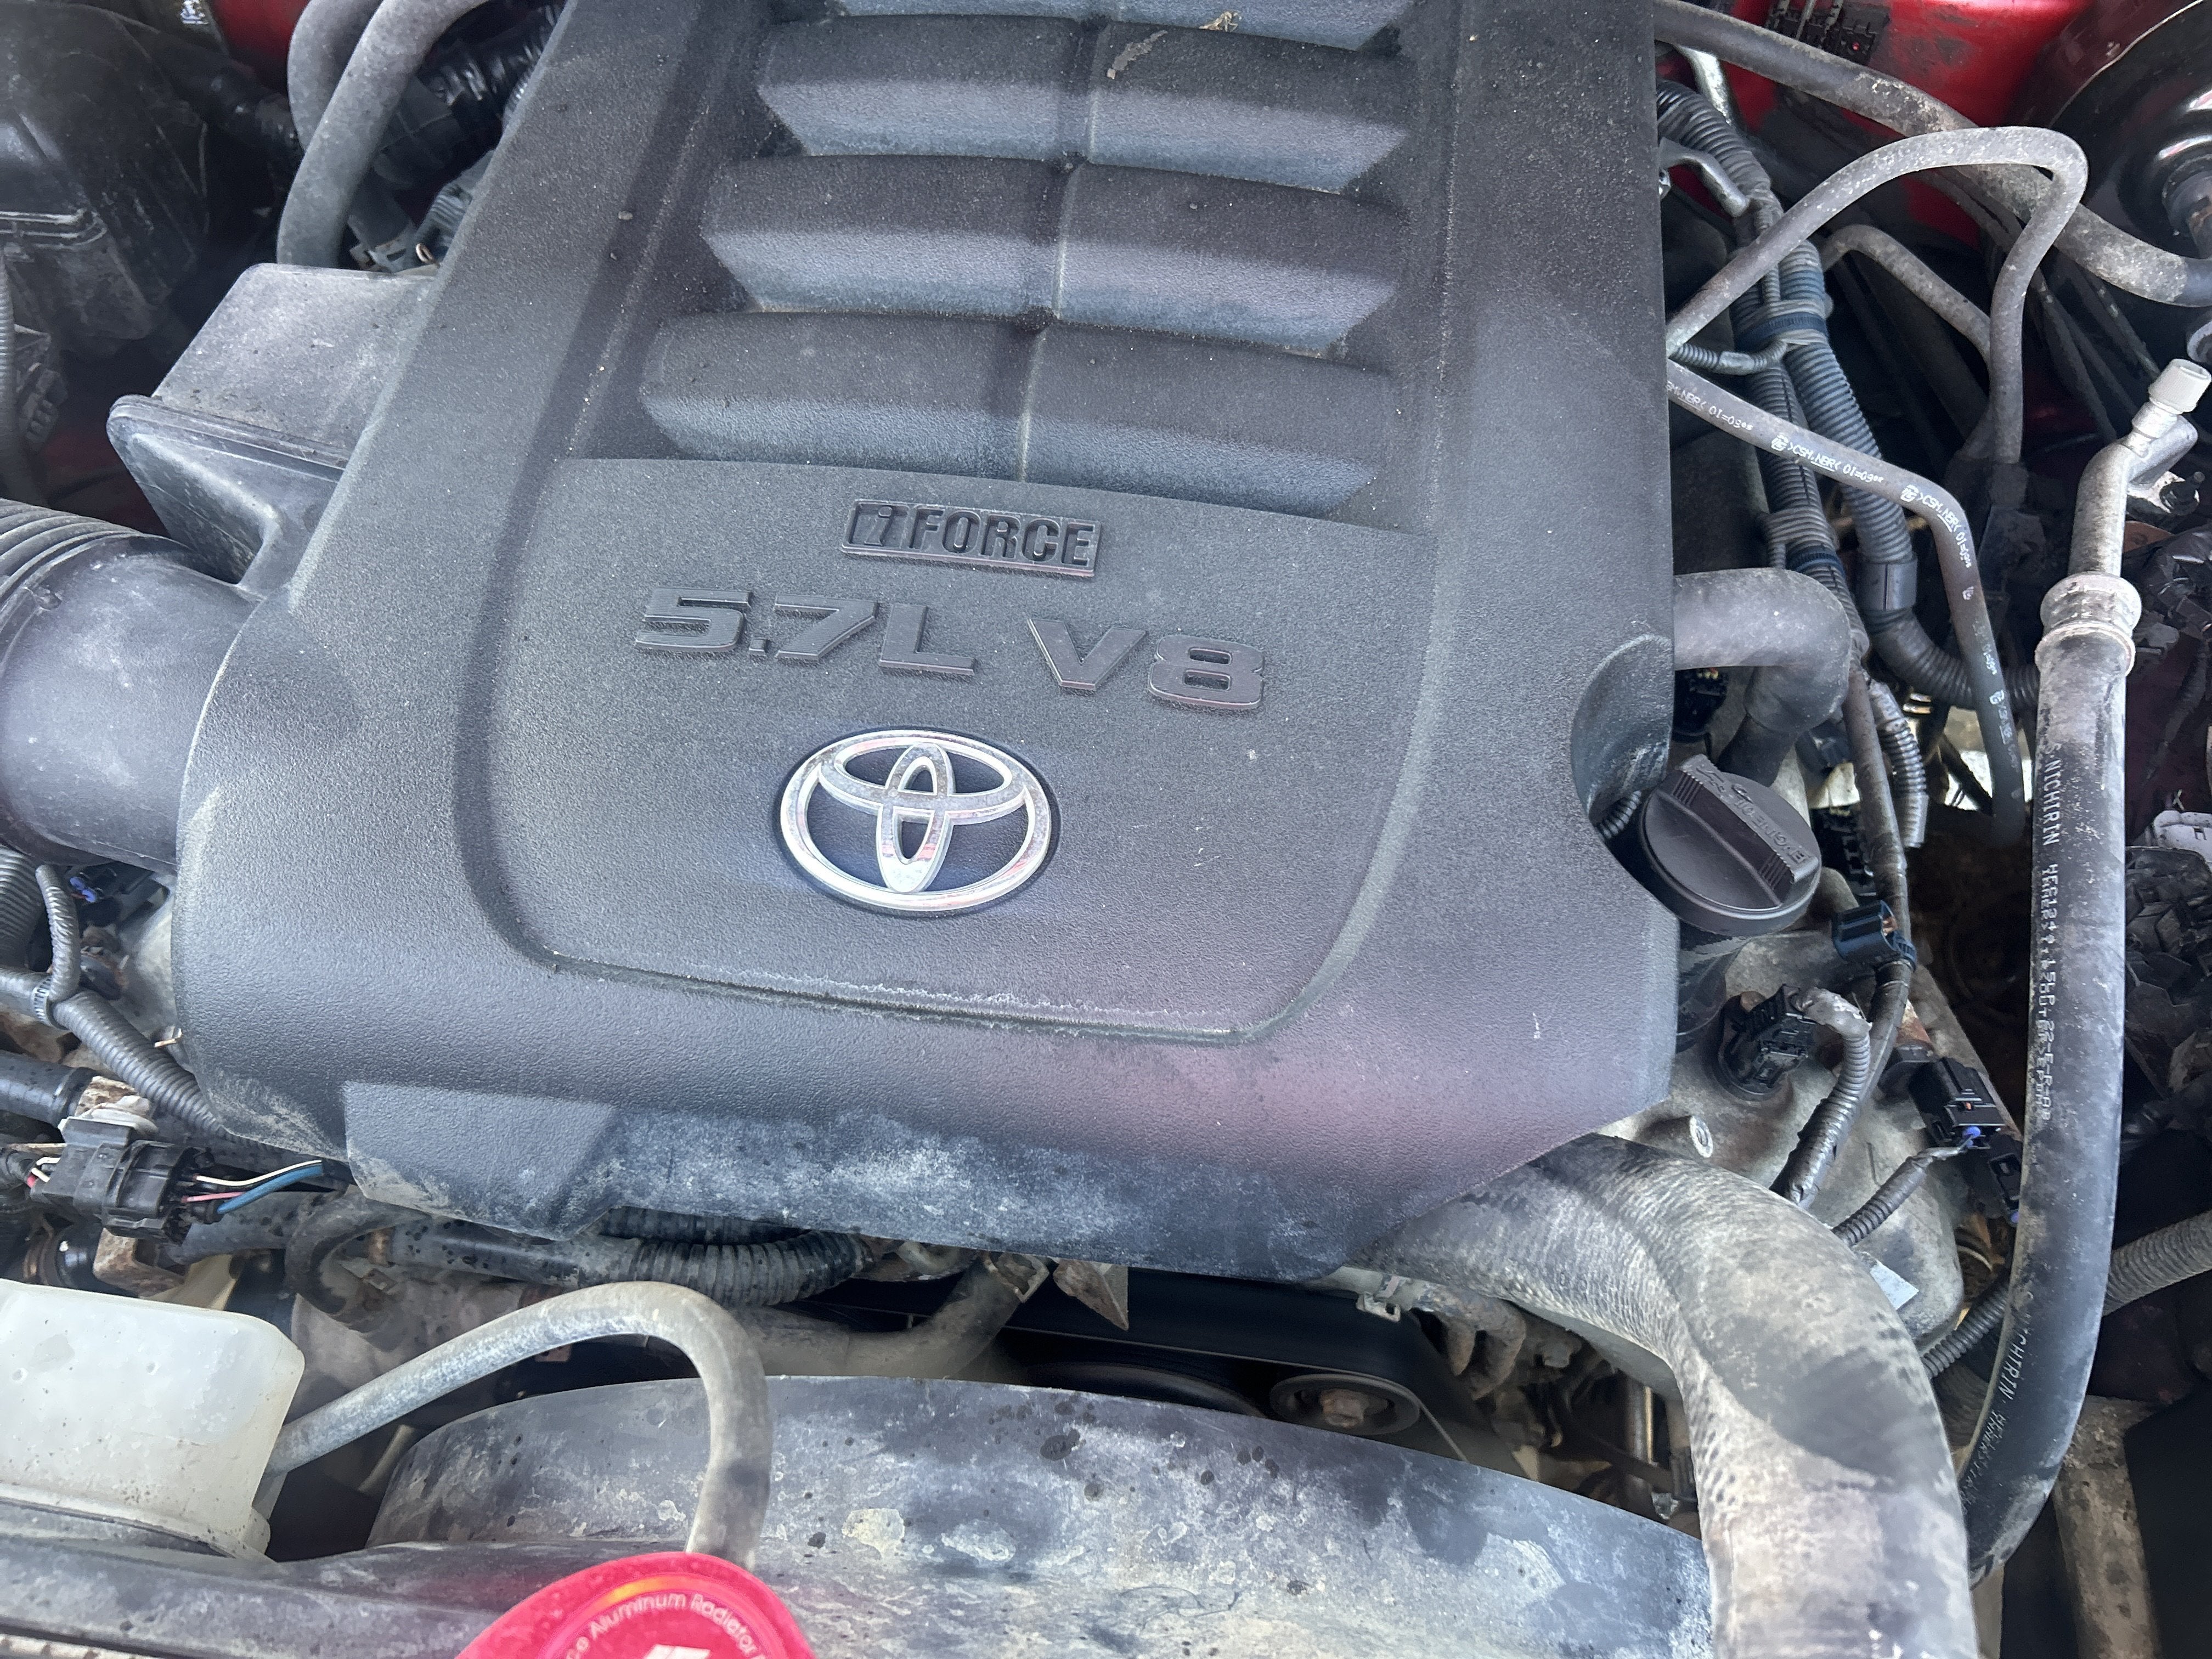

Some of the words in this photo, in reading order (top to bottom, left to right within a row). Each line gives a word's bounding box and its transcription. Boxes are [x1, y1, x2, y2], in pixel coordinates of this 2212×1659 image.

[635, 586, 977, 677] 5.7L
[1026, 616, 1267, 711] V8
[690, 1593, 757, 1656] Radiator
